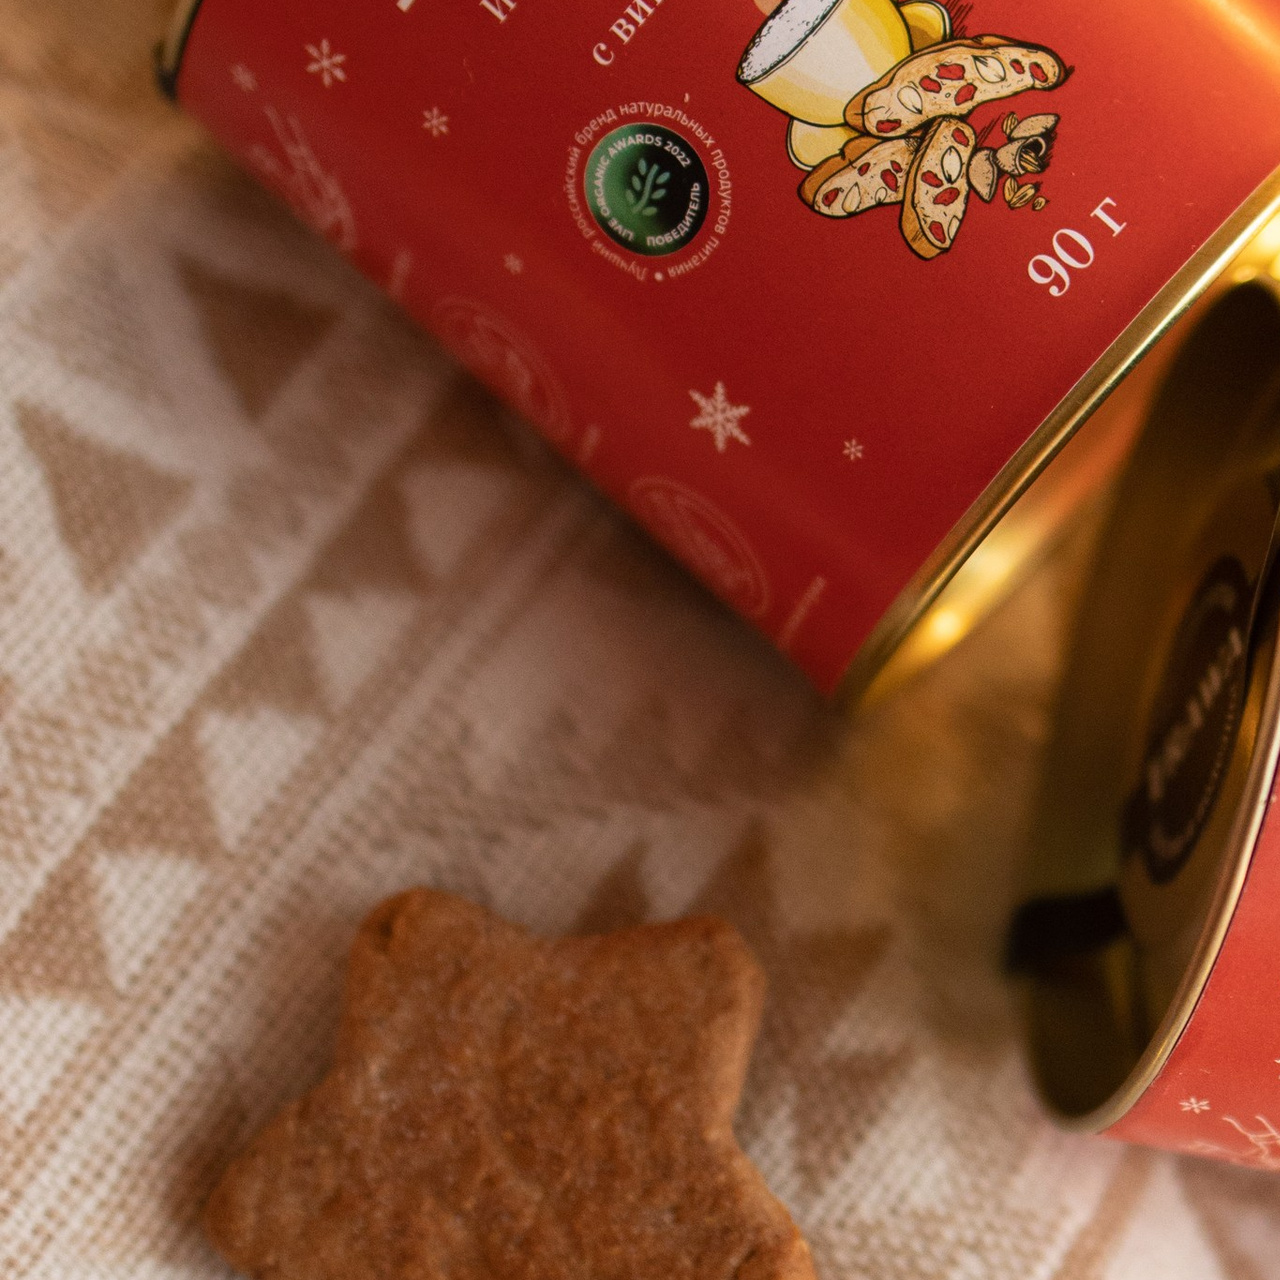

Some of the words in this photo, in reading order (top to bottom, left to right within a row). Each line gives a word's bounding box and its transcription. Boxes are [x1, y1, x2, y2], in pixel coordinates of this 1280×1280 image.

[591, 41, 615, 67] с
[574, 107, 618, 146] бренд
[607, 133, 663, 158] AWARDS
[618, 101, 716, 148] натуральных
[663, 140, 692, 169] 2022
[594, 154, 611, 218] ORGANIC
[710, 148, 733, 236] продуктов
[608, 216, 636, 243] LIVE
[646, 181, 702, 247] ПОБЕДИТЕЛЬ
[667, 235, 720, 278] питания
[1027, 228, 1095, 297] 90
[1089, 196, 1127, 238] г
